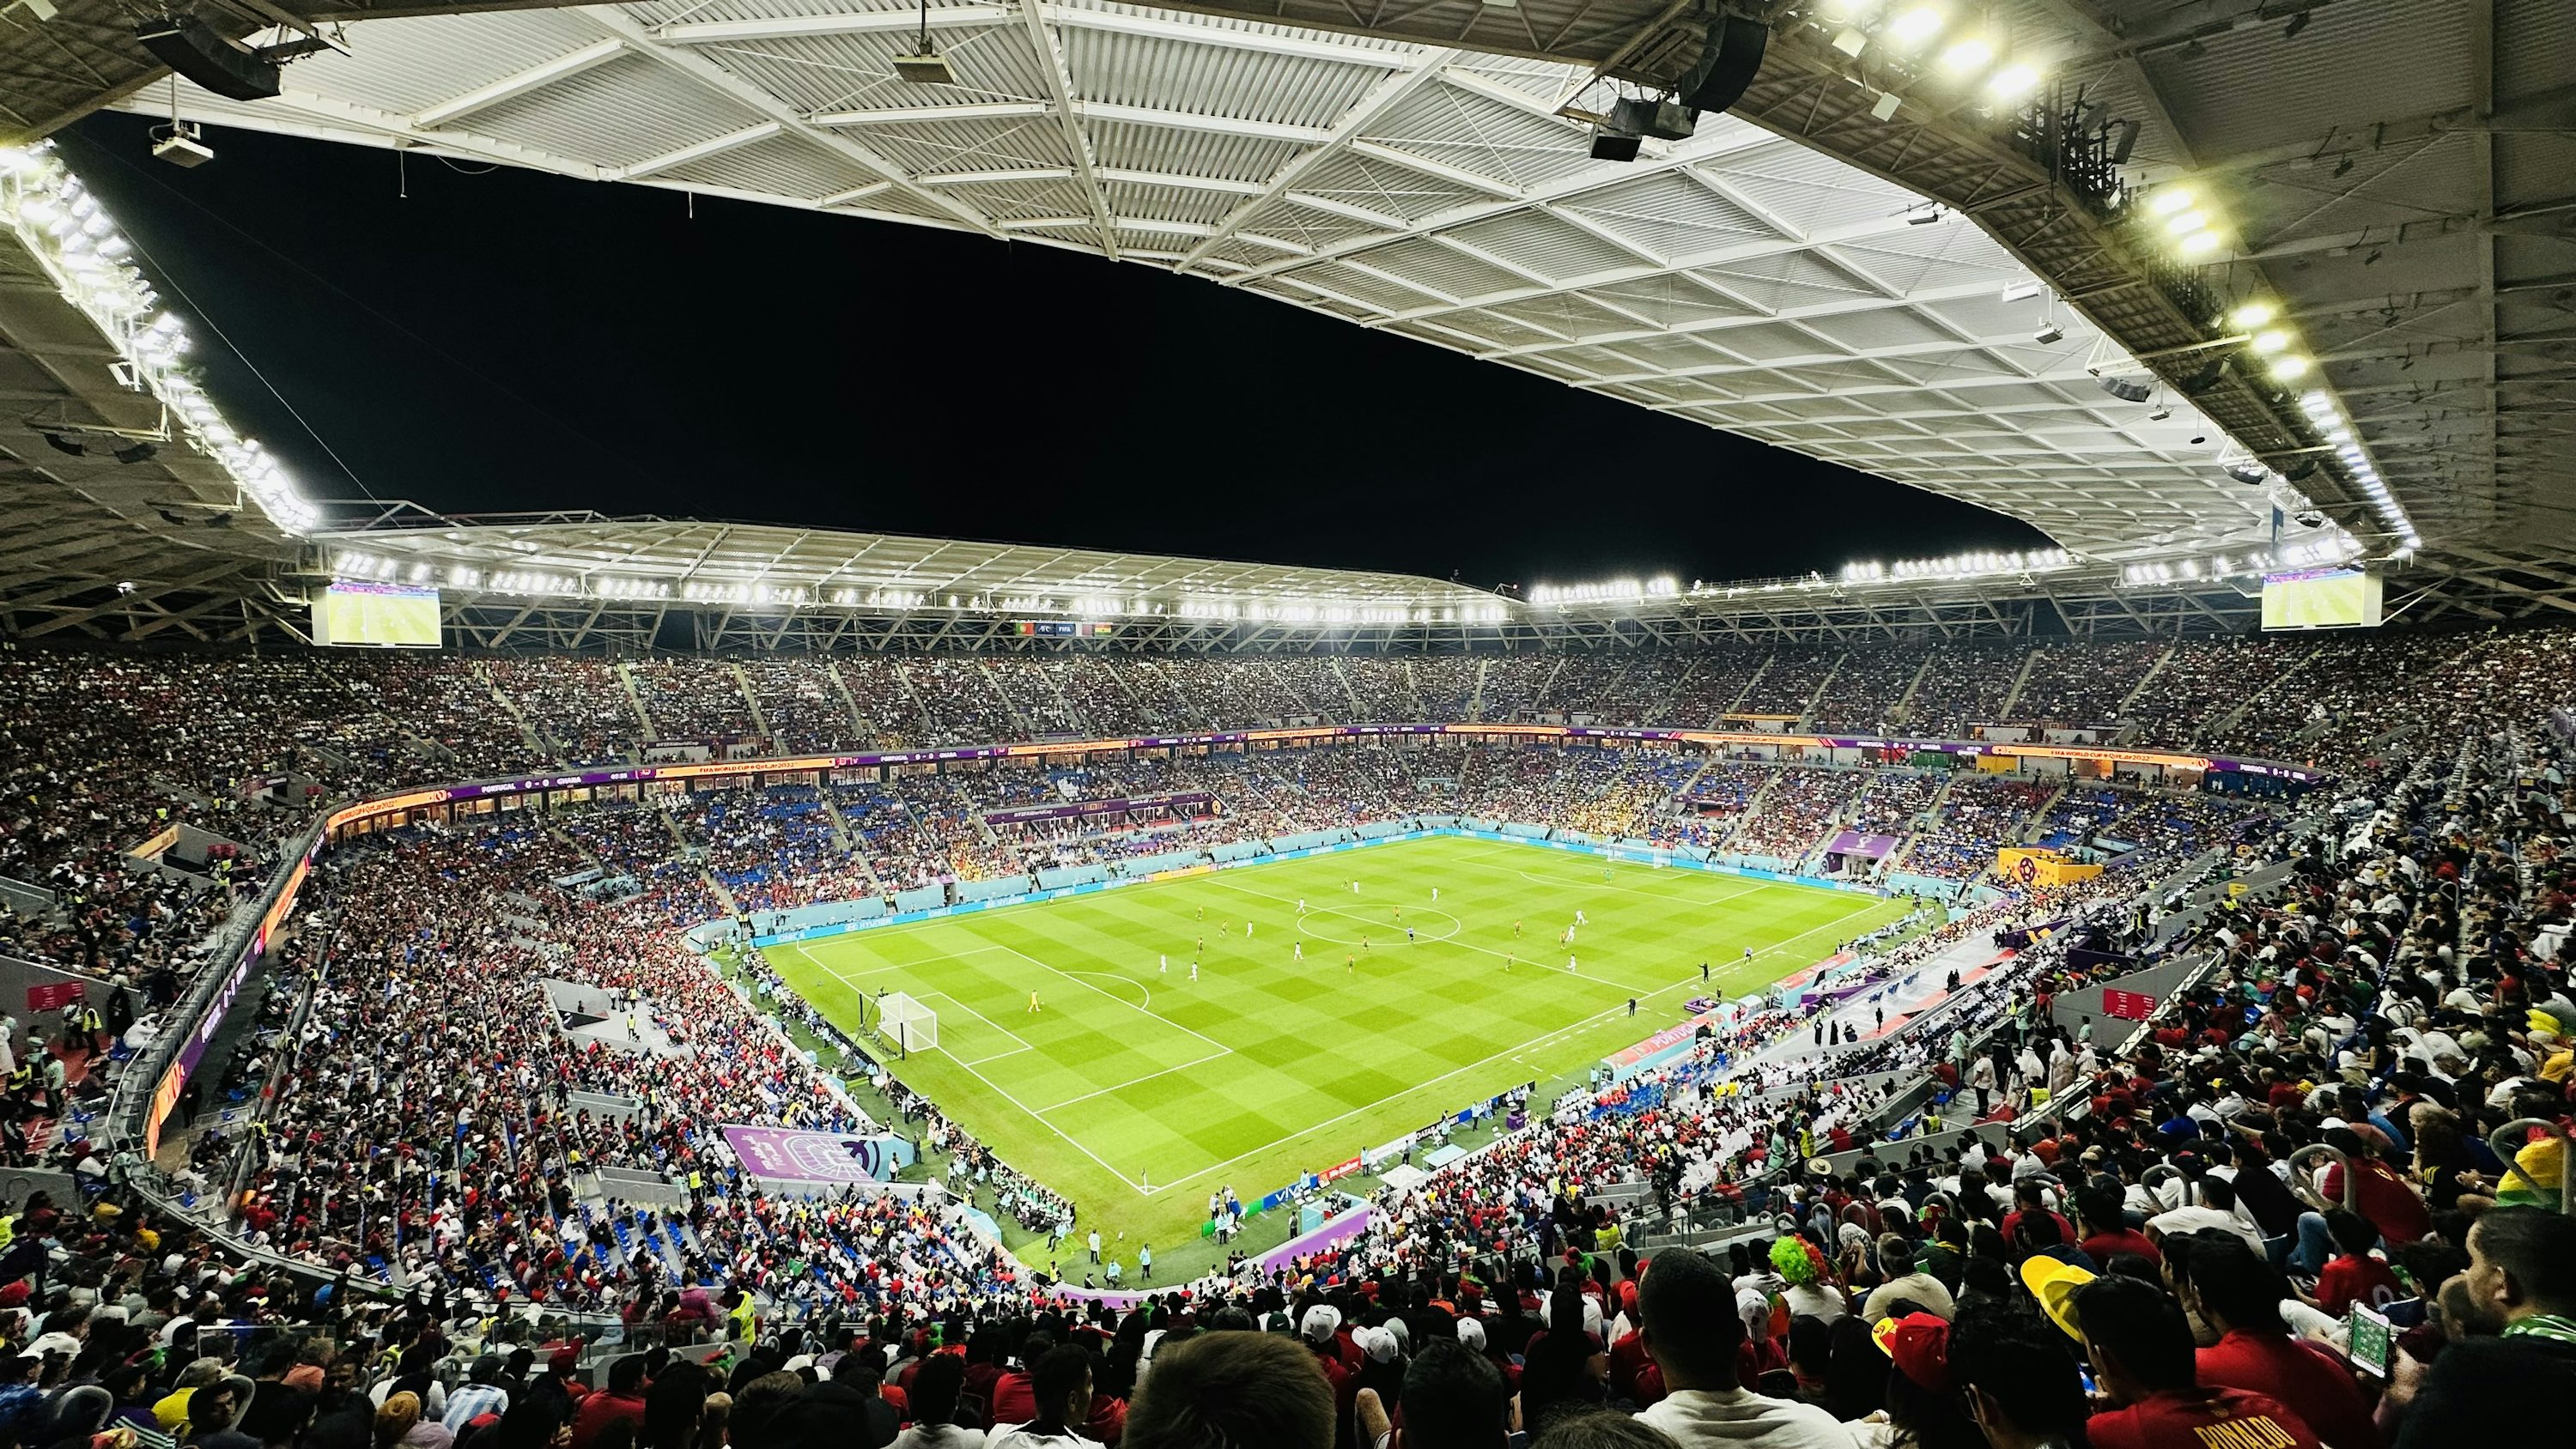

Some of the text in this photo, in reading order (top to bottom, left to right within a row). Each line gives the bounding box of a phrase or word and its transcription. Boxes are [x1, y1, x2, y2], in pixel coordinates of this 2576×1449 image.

[481, 783, 517, 794] PORTUGAL
[525, 780, 532, 789] 0
[543, 779, 550, 787] 0
[556, 776, 582, 785] GHANA
[2193, 1415, 2297, 1449] RONALDO
